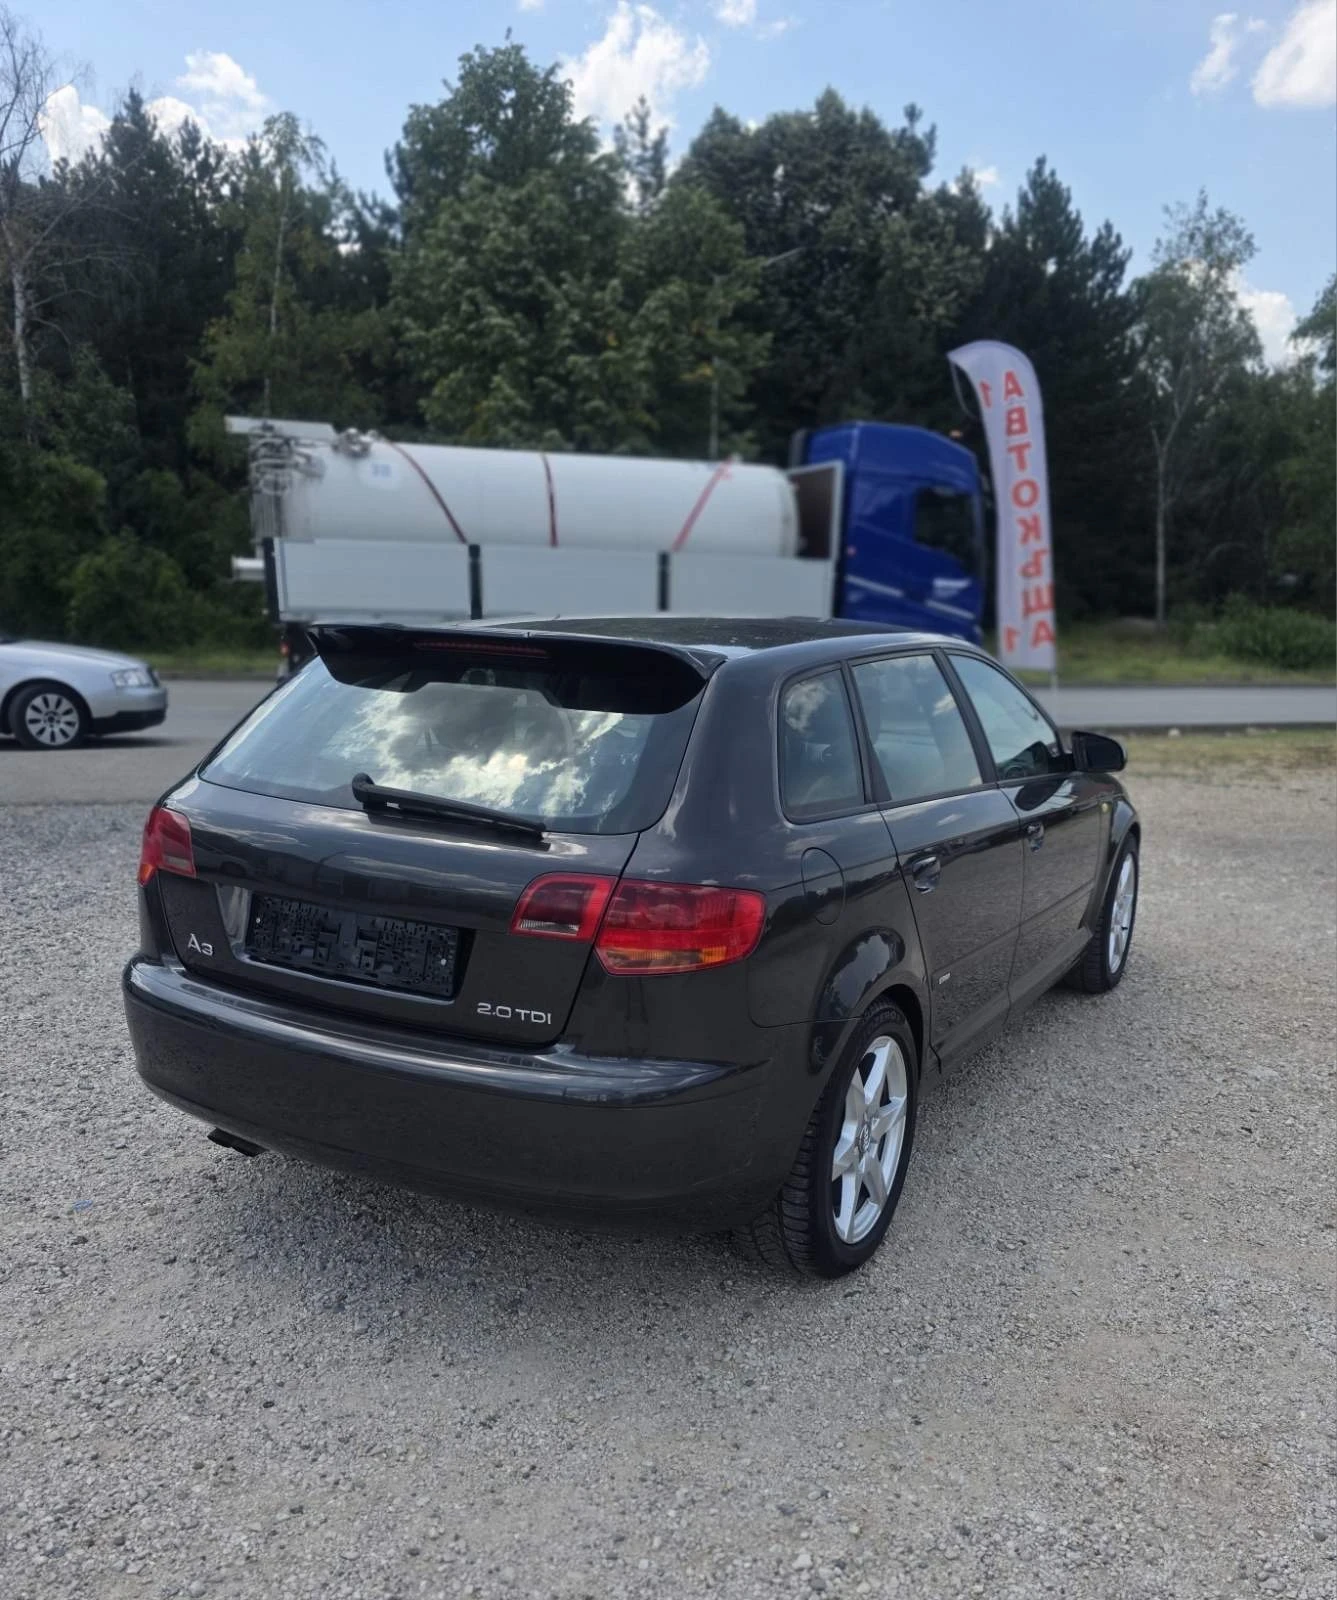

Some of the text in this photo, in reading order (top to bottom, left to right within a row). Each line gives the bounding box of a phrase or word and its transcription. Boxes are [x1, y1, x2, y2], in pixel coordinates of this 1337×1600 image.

[187, 932, 214, 957] A3
[477, 1002, 552, 1025] 2.0 TDI
